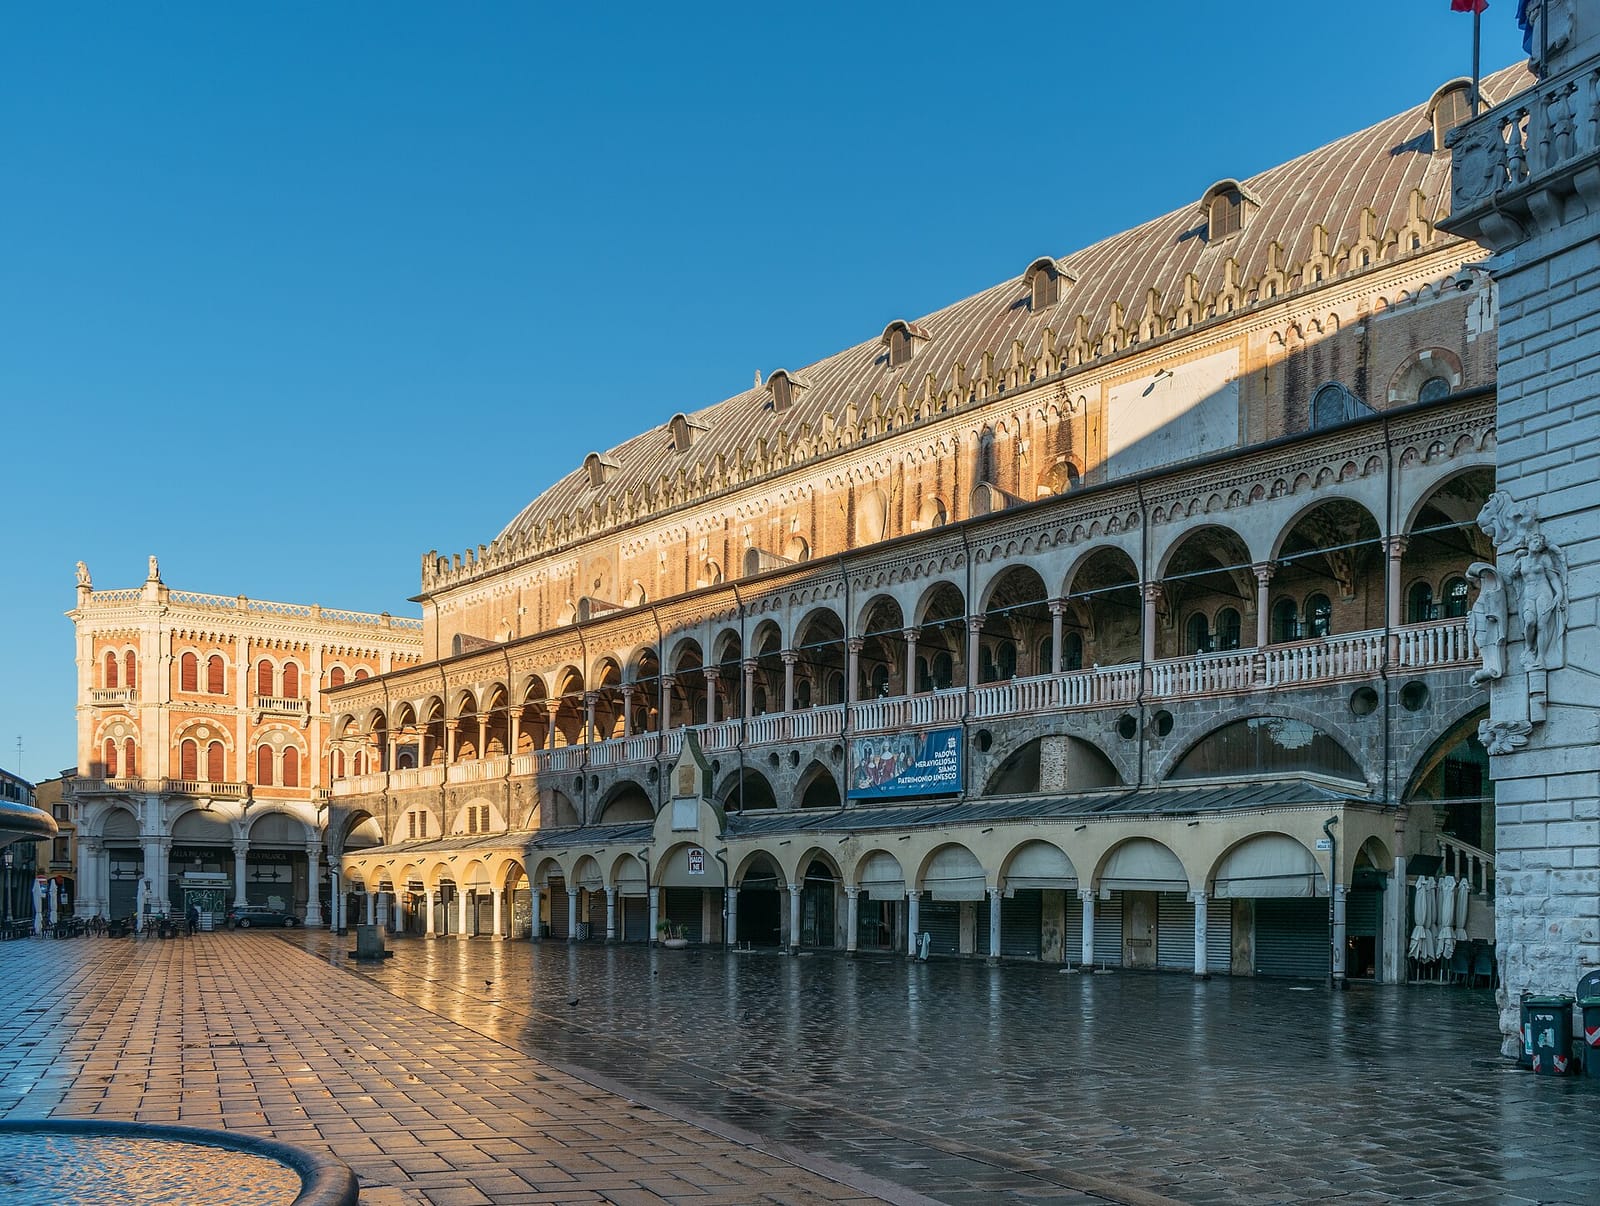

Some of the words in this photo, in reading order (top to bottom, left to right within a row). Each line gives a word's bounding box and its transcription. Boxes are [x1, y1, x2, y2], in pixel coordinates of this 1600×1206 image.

[935, 750, 957, 759] PADOVA
[938, 765, 957, 774] SIAMO
[898, 775, 932, 784] PATRIMONIO
[933, 772, 957, 781] UNESCO
